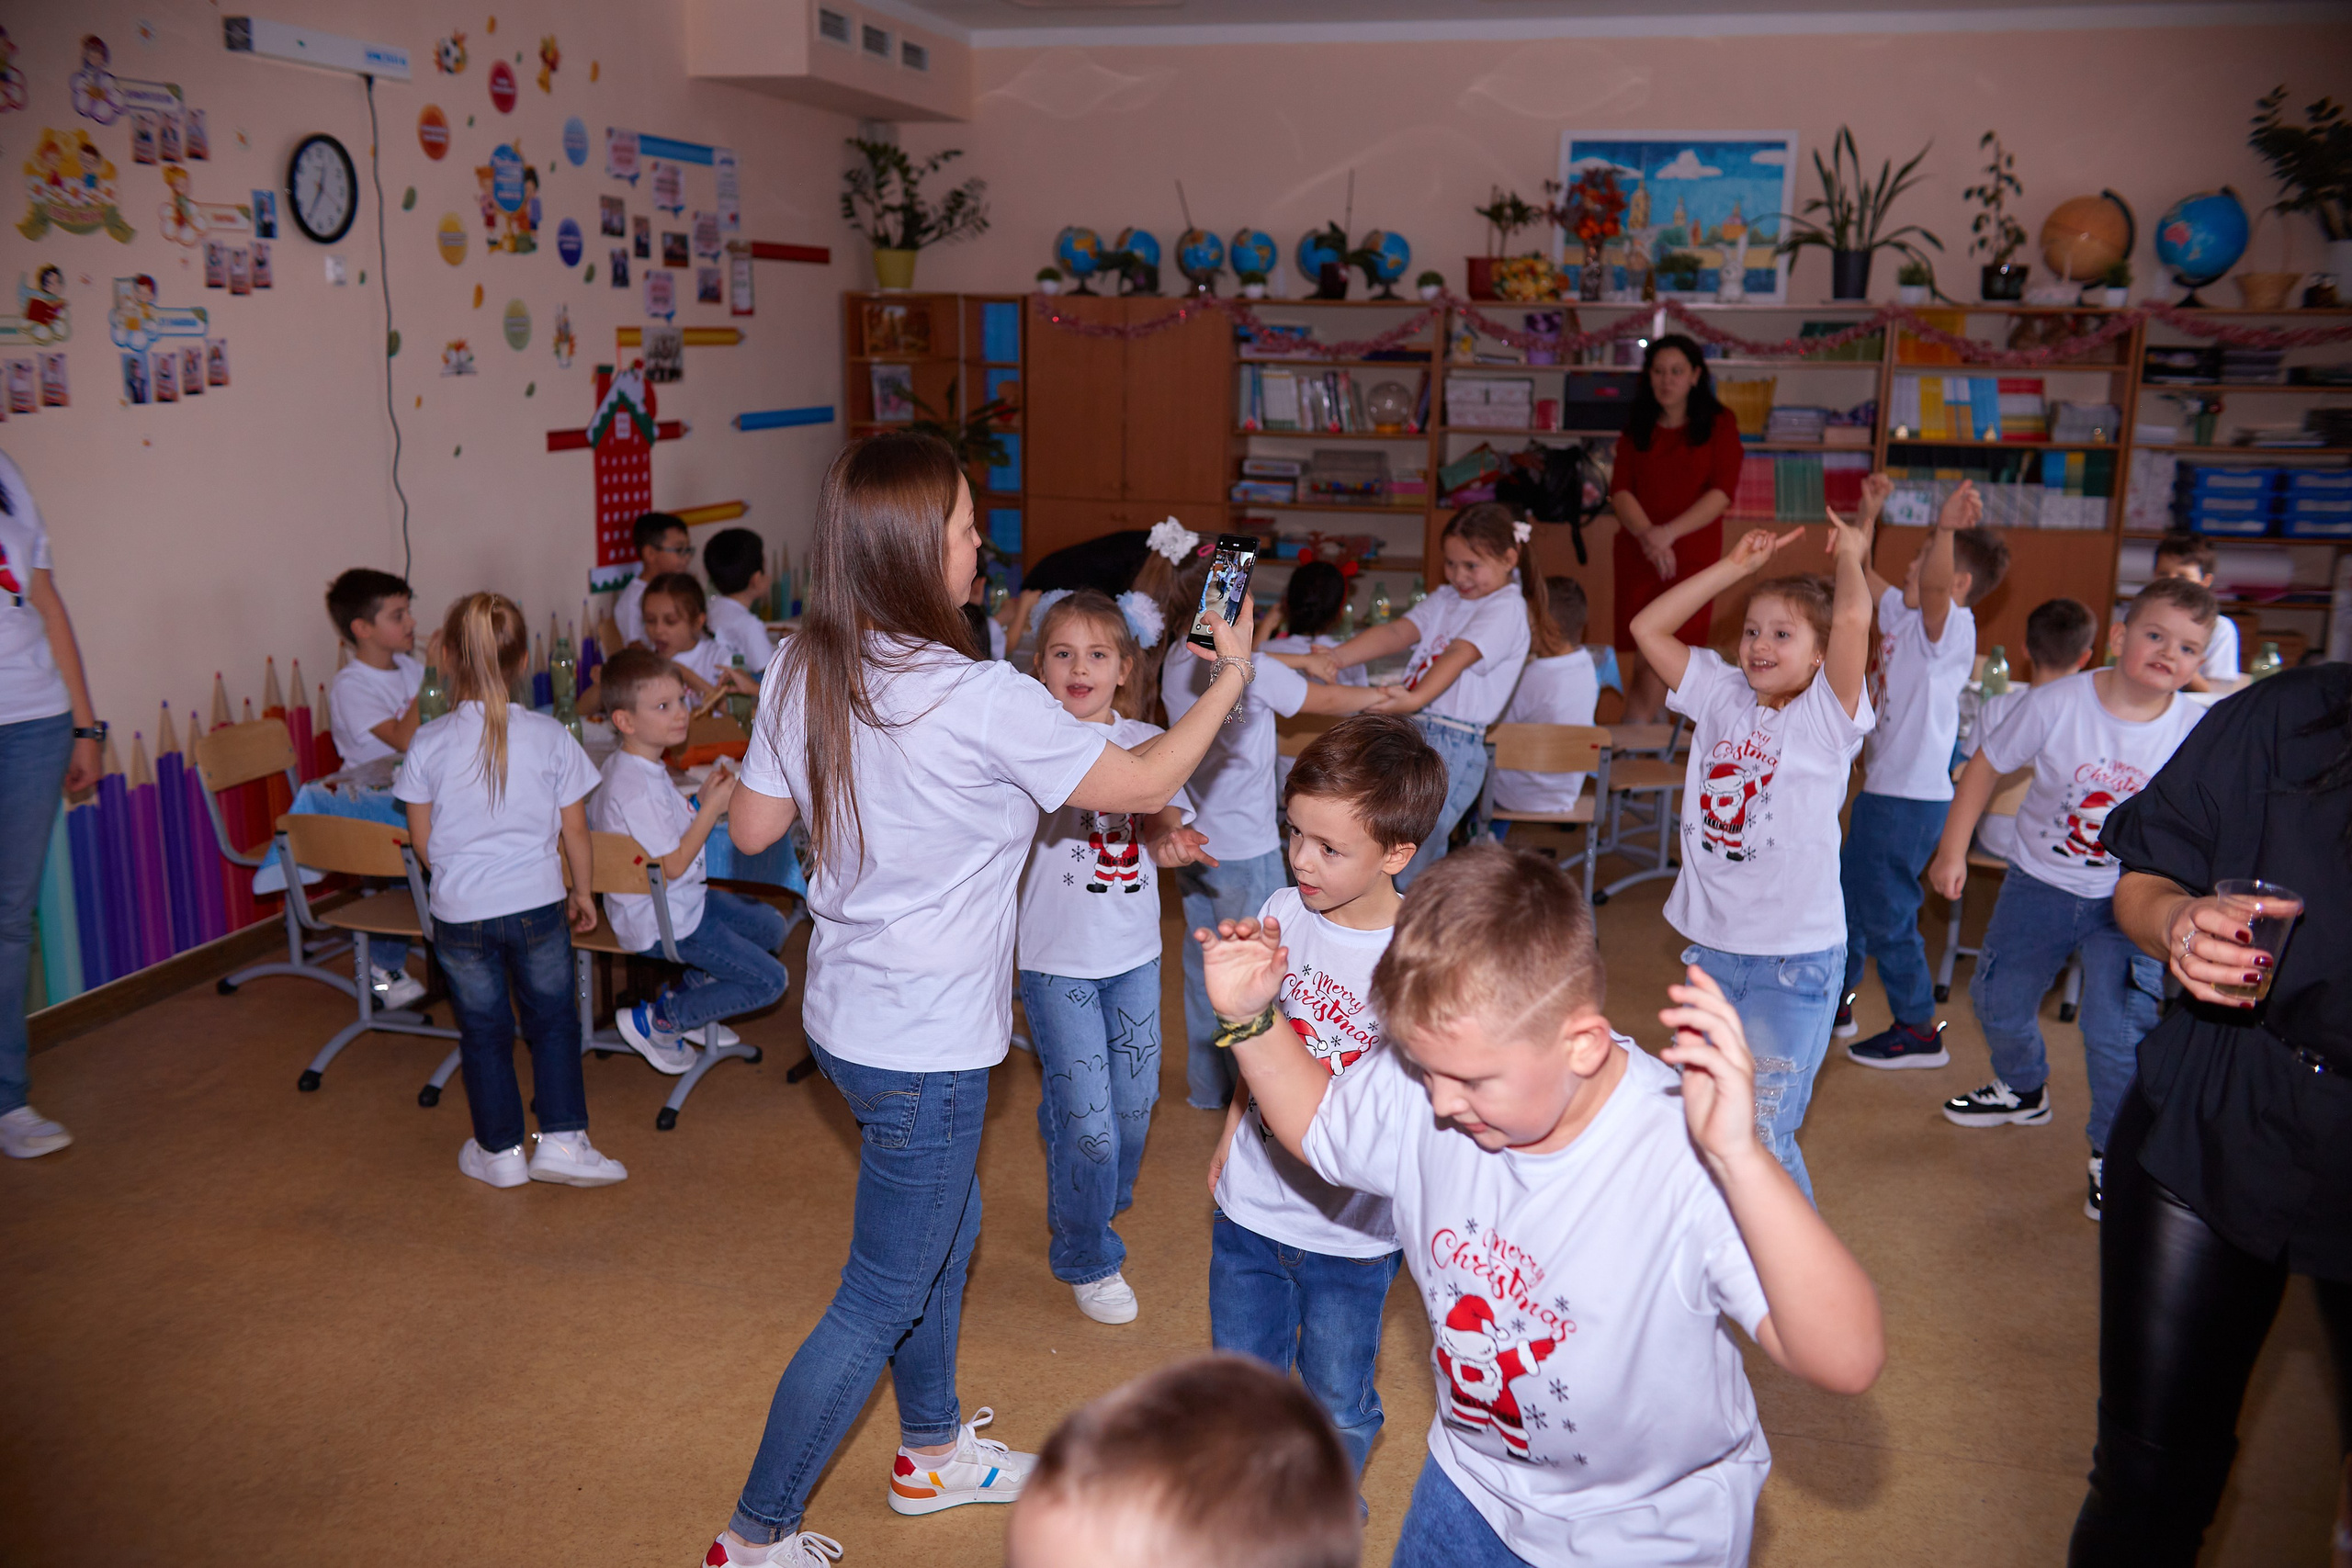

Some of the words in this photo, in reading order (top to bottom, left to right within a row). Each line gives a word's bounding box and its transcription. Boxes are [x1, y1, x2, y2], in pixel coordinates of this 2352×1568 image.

[2075, 763, 2142, 795] Christ
[1278, 973, 1381, 1054] Christmas
[1312, 970, 1367, 1016] Merry
[1430, 1227, 1577, 1343] Christmas
[1483, 1227, 1548, 1289] Merry
